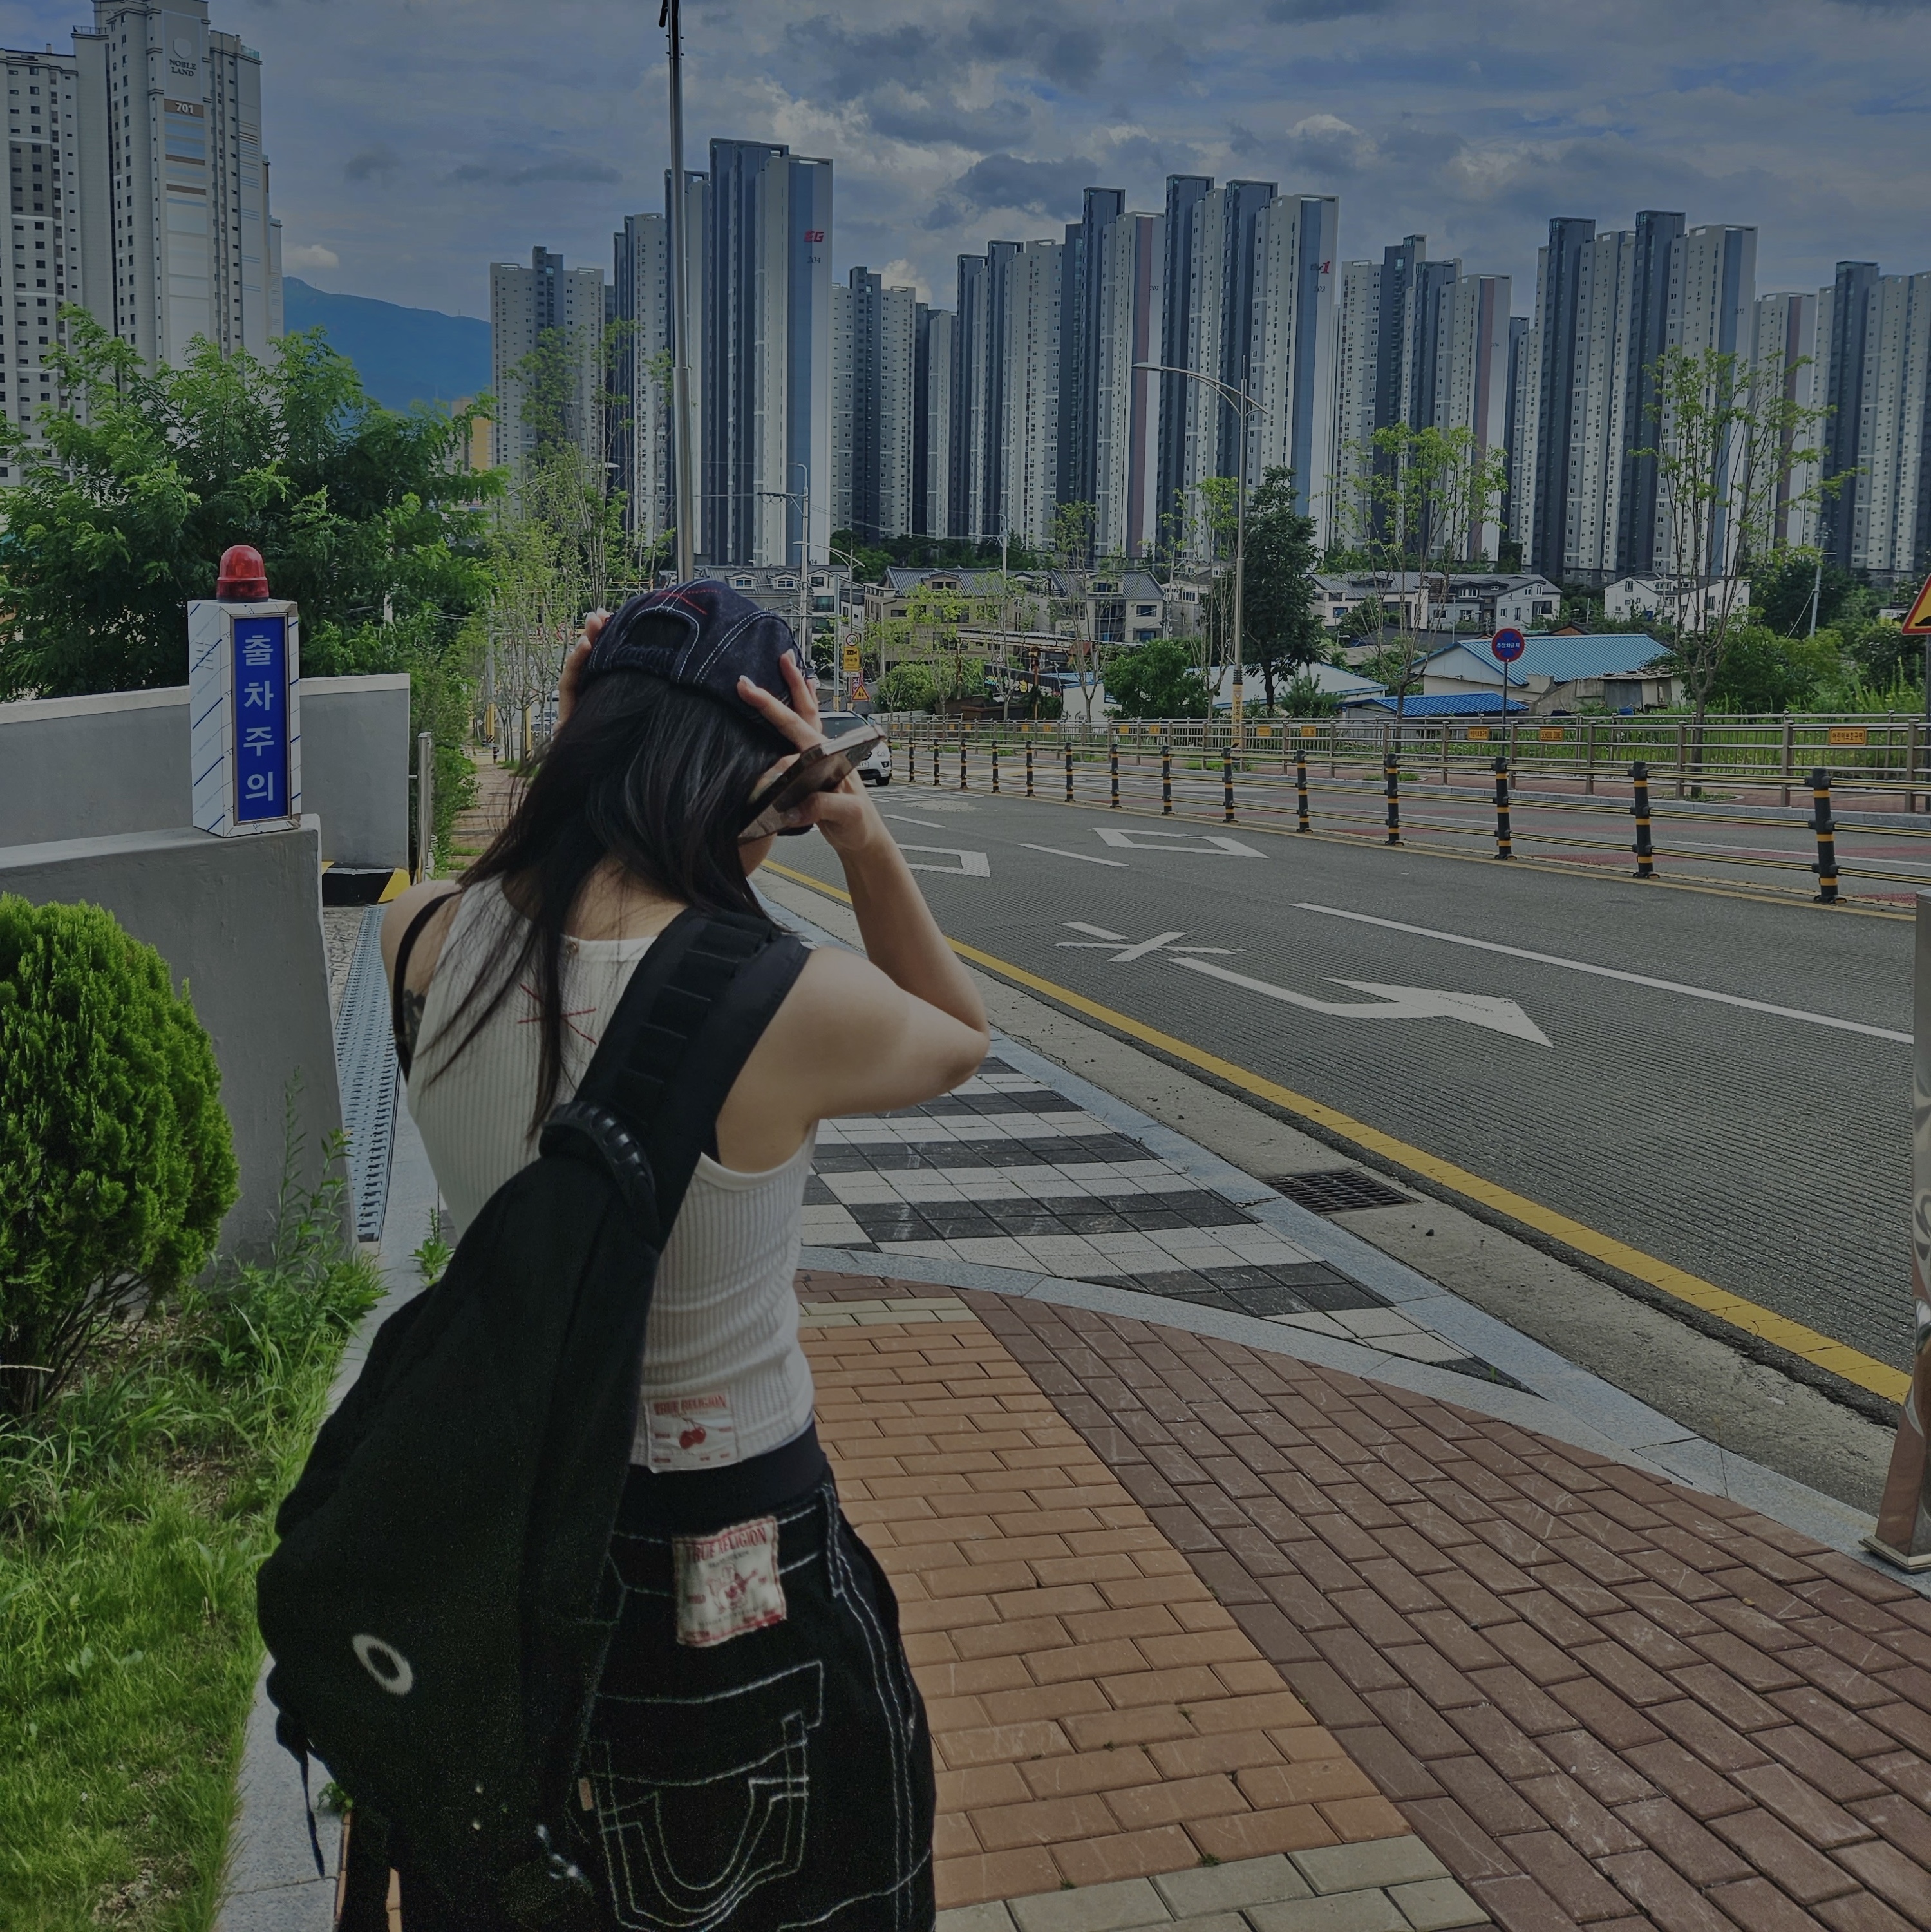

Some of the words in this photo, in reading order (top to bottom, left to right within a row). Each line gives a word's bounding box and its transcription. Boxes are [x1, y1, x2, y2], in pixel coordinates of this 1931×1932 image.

[169, 59, 196, 70] NOBLE
[171, 66, 194, 77] LAND
[175, 102, 193, 115] 701
[242, 634, 275, 802] 출차주의
